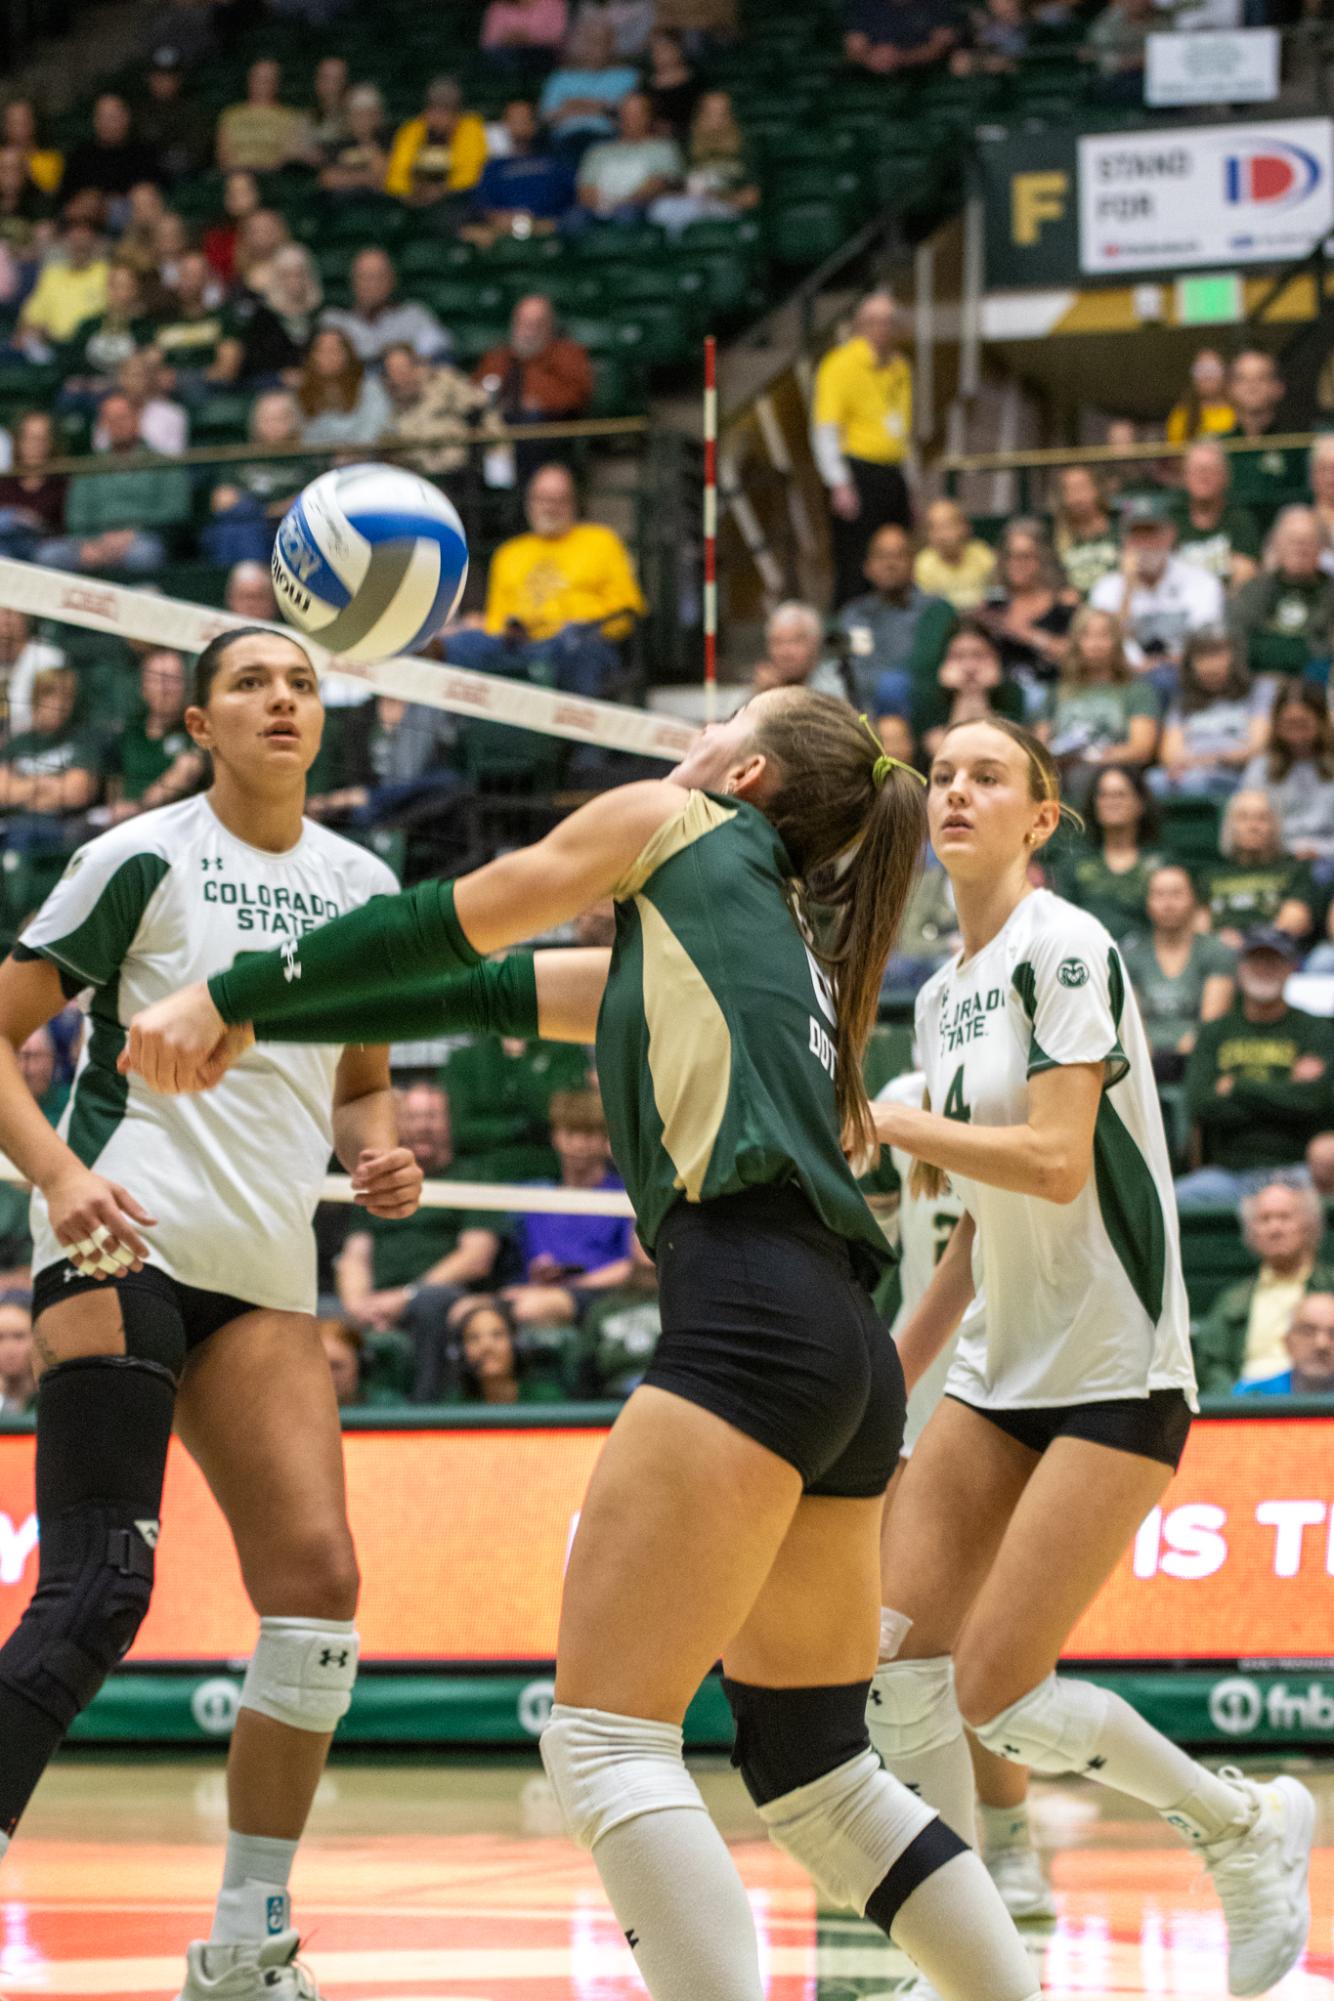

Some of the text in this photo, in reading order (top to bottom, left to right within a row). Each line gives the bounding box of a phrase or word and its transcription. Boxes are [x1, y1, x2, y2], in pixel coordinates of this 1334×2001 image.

[1099, 151, 1191, 181] STAND
[1012, 170, 1067, 246] F
[1099, 195, 1153, 220] FOR
[204, 880, 339, 921] COLORADO
[237, 908, 315, 936] STATE
[943, 1063, 971, 1123] 4
[1255, 1500, 1334, 1579] T
